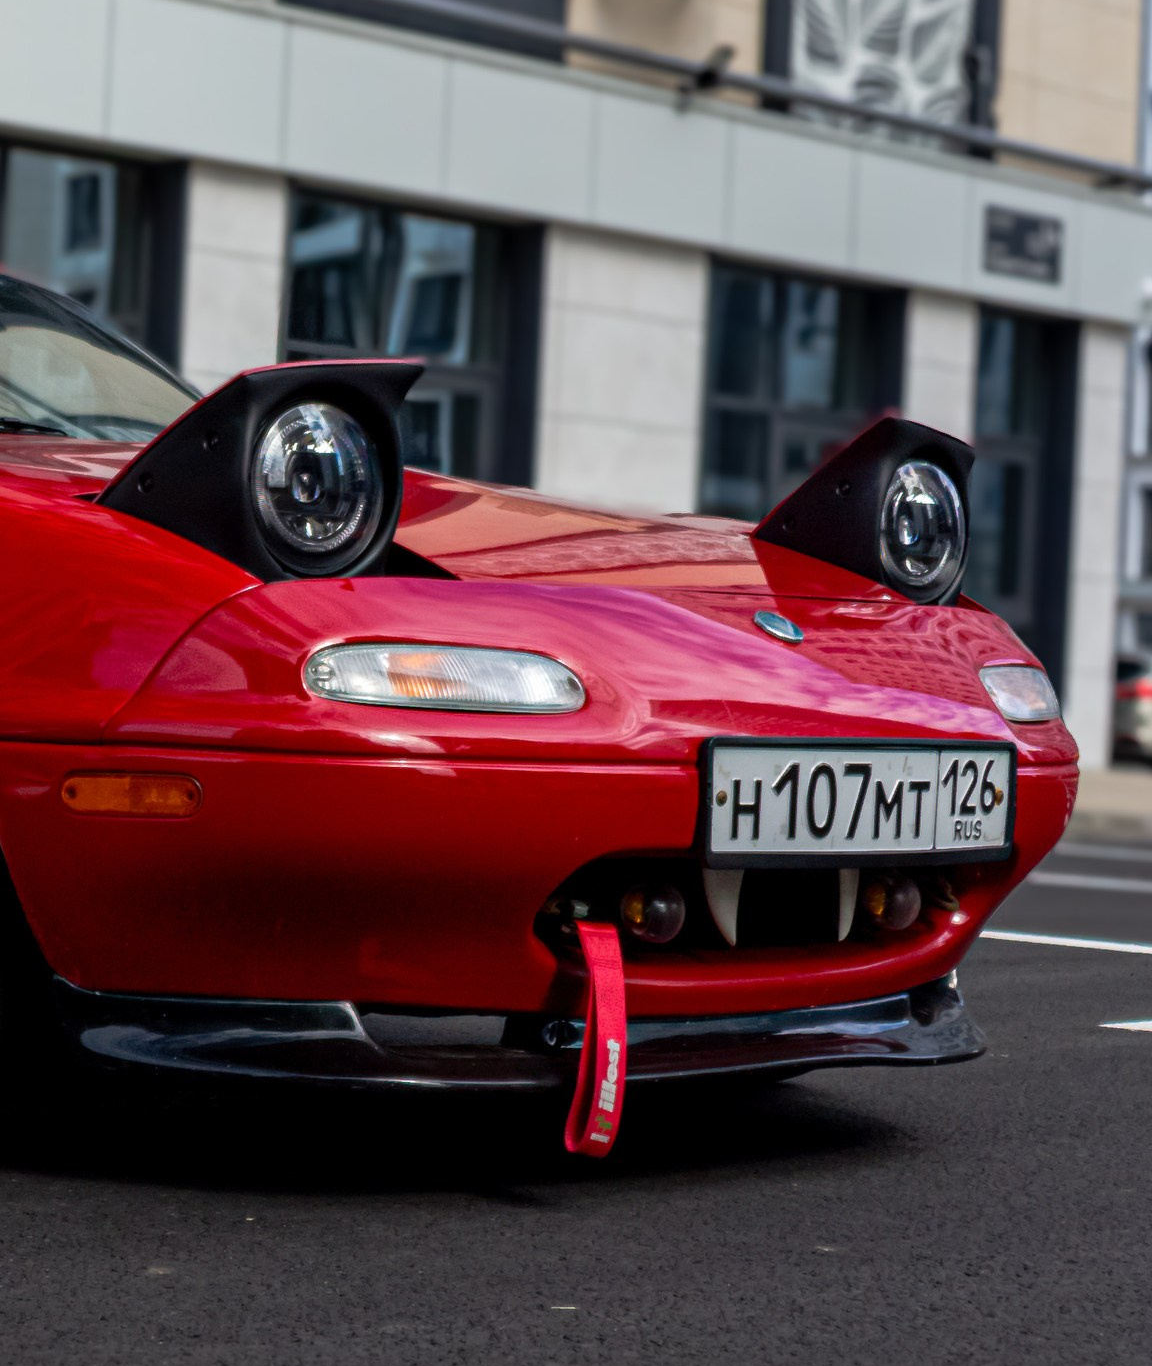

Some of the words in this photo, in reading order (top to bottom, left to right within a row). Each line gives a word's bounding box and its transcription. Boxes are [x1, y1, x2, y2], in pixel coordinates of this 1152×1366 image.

[941, 759, 996, 817] 126
[953, 819, 983, 841] RUS
[598, 1038, 620, 1113] illest
